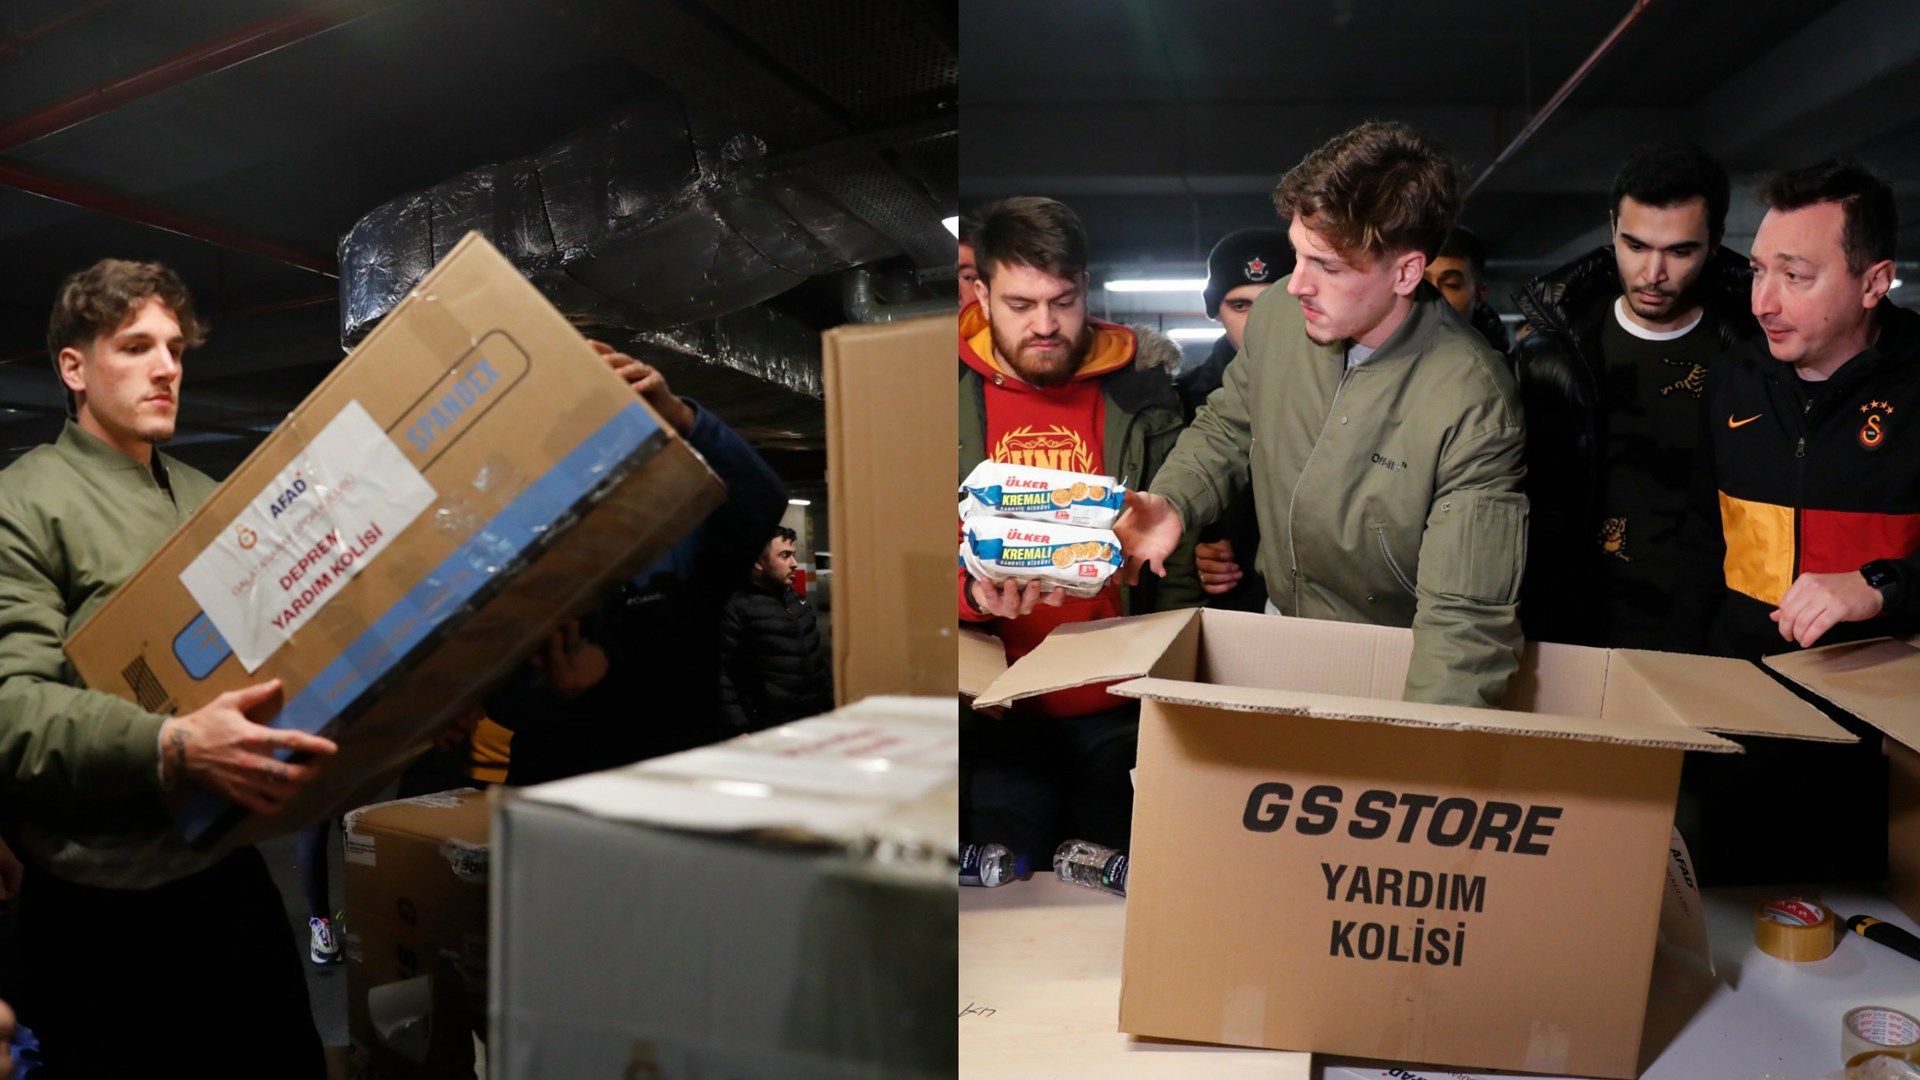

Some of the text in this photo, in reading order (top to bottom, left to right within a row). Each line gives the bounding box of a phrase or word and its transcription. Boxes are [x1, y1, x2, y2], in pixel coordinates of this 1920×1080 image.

[406, 358, 502, 452] SPANDEX
[270, 479, 307, 519] AFAD
[1002, 492, 1051, 506] KREMALI
[1006, 476, 1049, 490] ÜLKER
[1002, 547, 1052, 560] KREMALI
[1007, 529, 1050, 544] ÜLKER
[271, 522, 384, 631] YARDIM KOLİSİ
[1242, 782, 1563, 856] GS STORE
[1320, 862, 1486, 913] YARDIM
[1329, 918, 1466, 966] KOLİSİ
